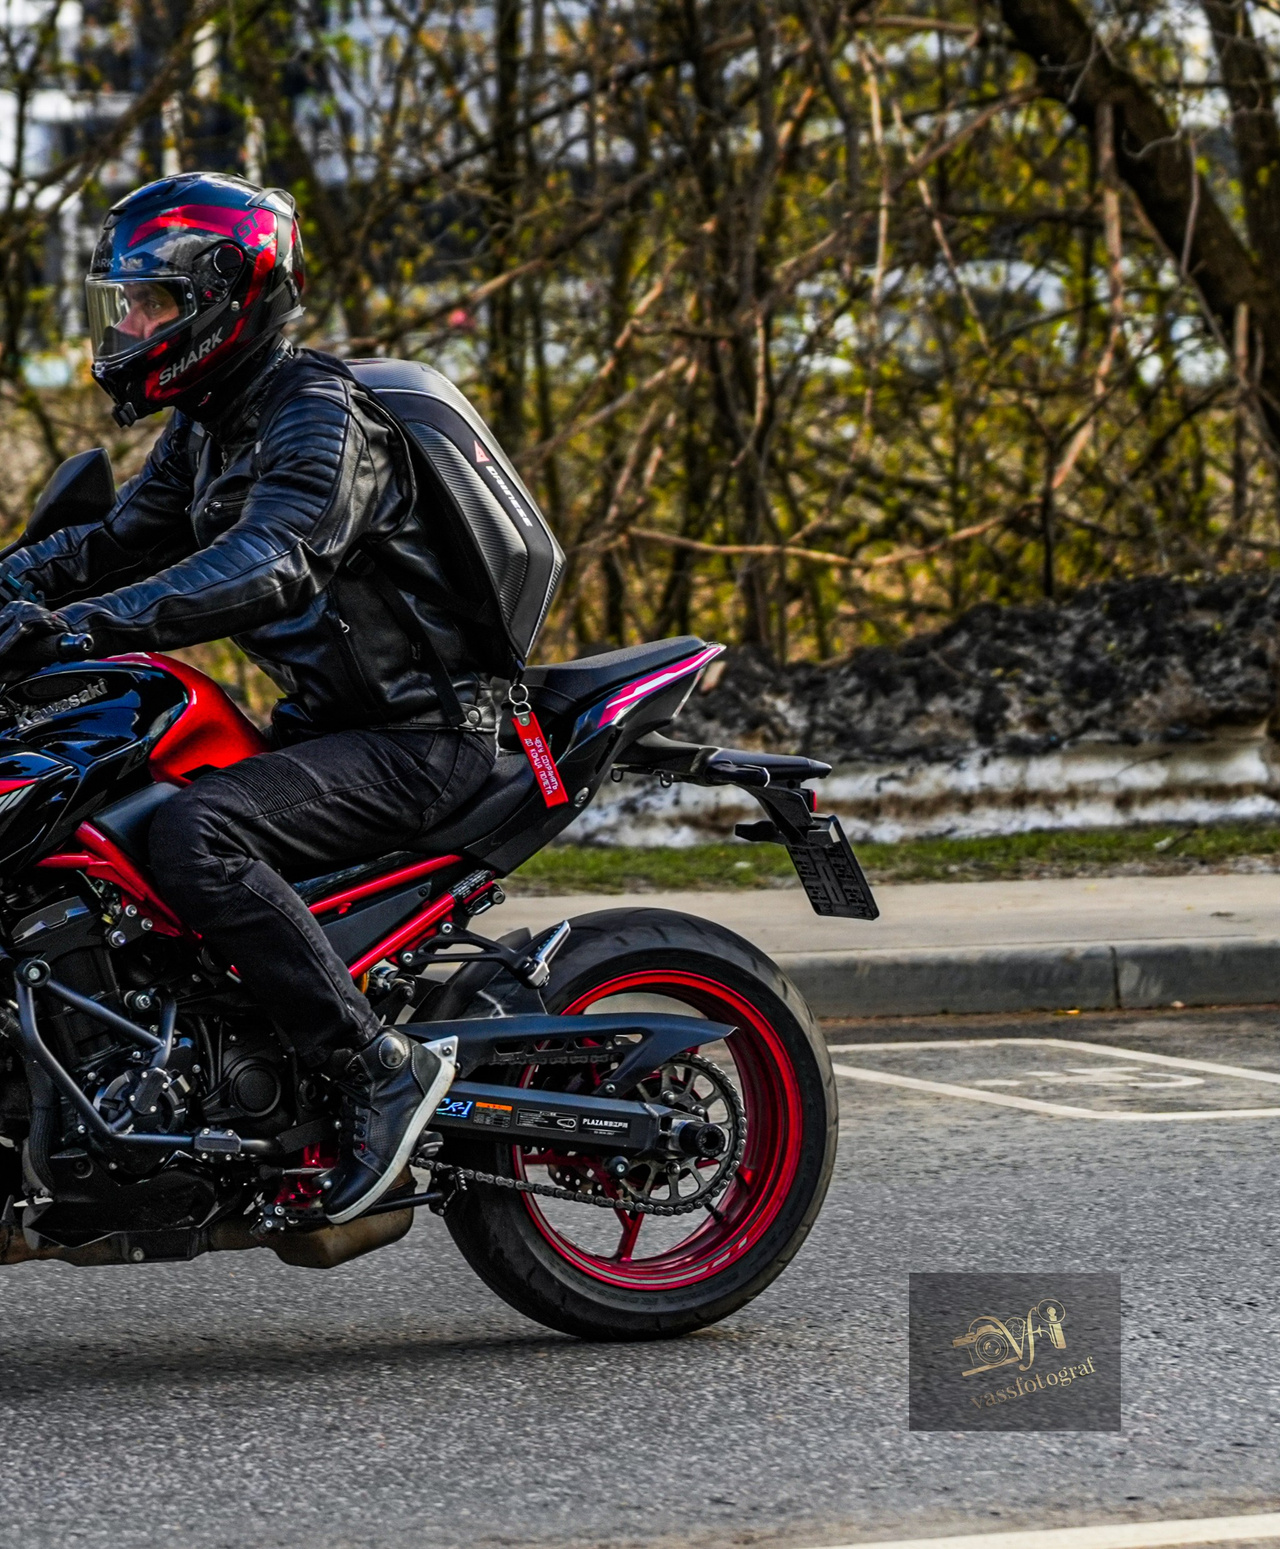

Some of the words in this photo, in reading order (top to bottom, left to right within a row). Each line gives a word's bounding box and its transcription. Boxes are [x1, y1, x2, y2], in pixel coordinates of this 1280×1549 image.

[232, 208, 258, 246] GT
[93, 257, 115, 268] ARK
[159, 326, 223, 386] SHARK
[485, 465, 533, 527] DAINESE
[15, 678, 108, 728] Kawasaki
